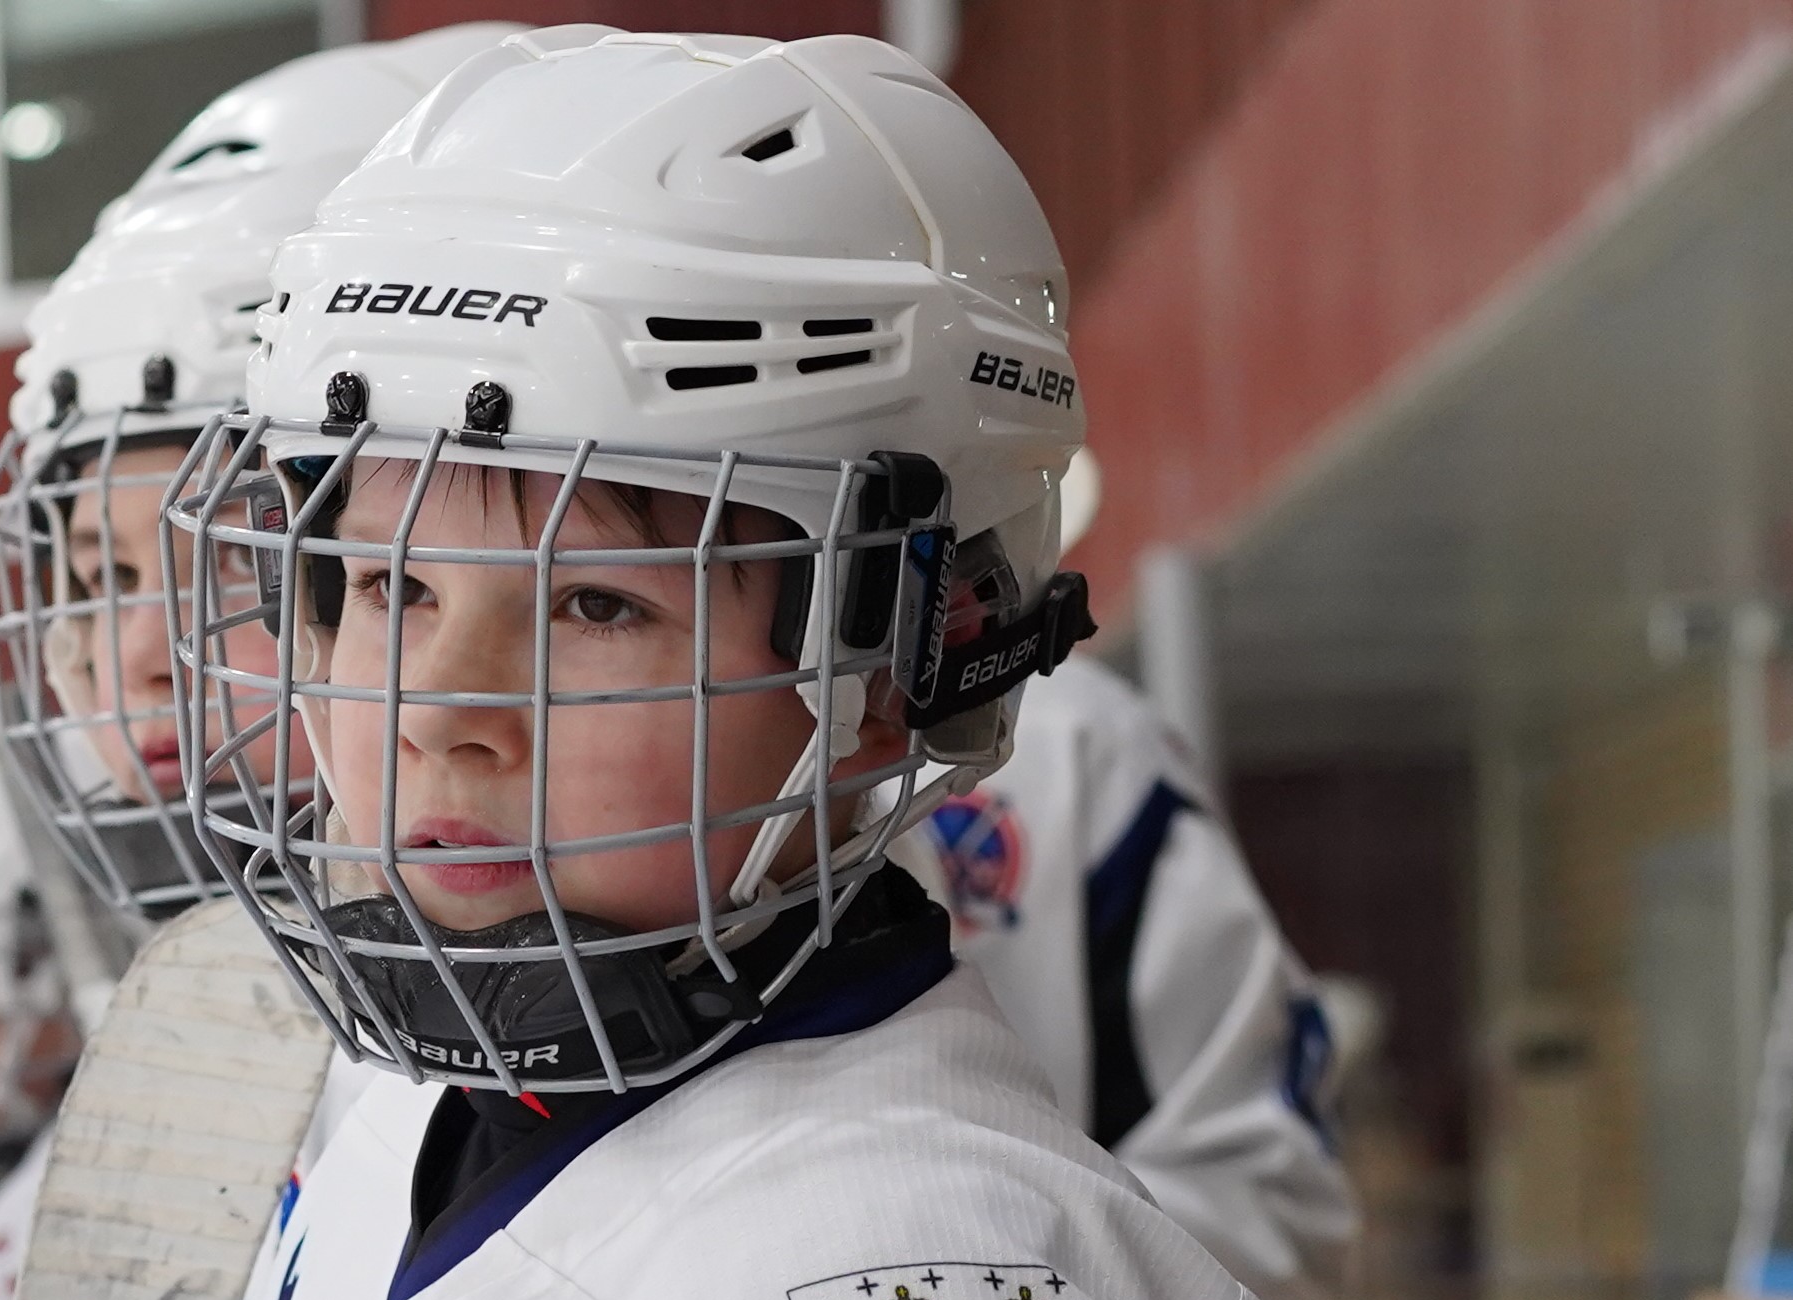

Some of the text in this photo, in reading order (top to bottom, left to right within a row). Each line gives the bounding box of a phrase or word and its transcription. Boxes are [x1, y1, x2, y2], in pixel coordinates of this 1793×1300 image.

[325, 282, 548, 328] BAUER
[970, 351, 1075, 409] BAUER
[959, 634, 1040, 691] BAUER
